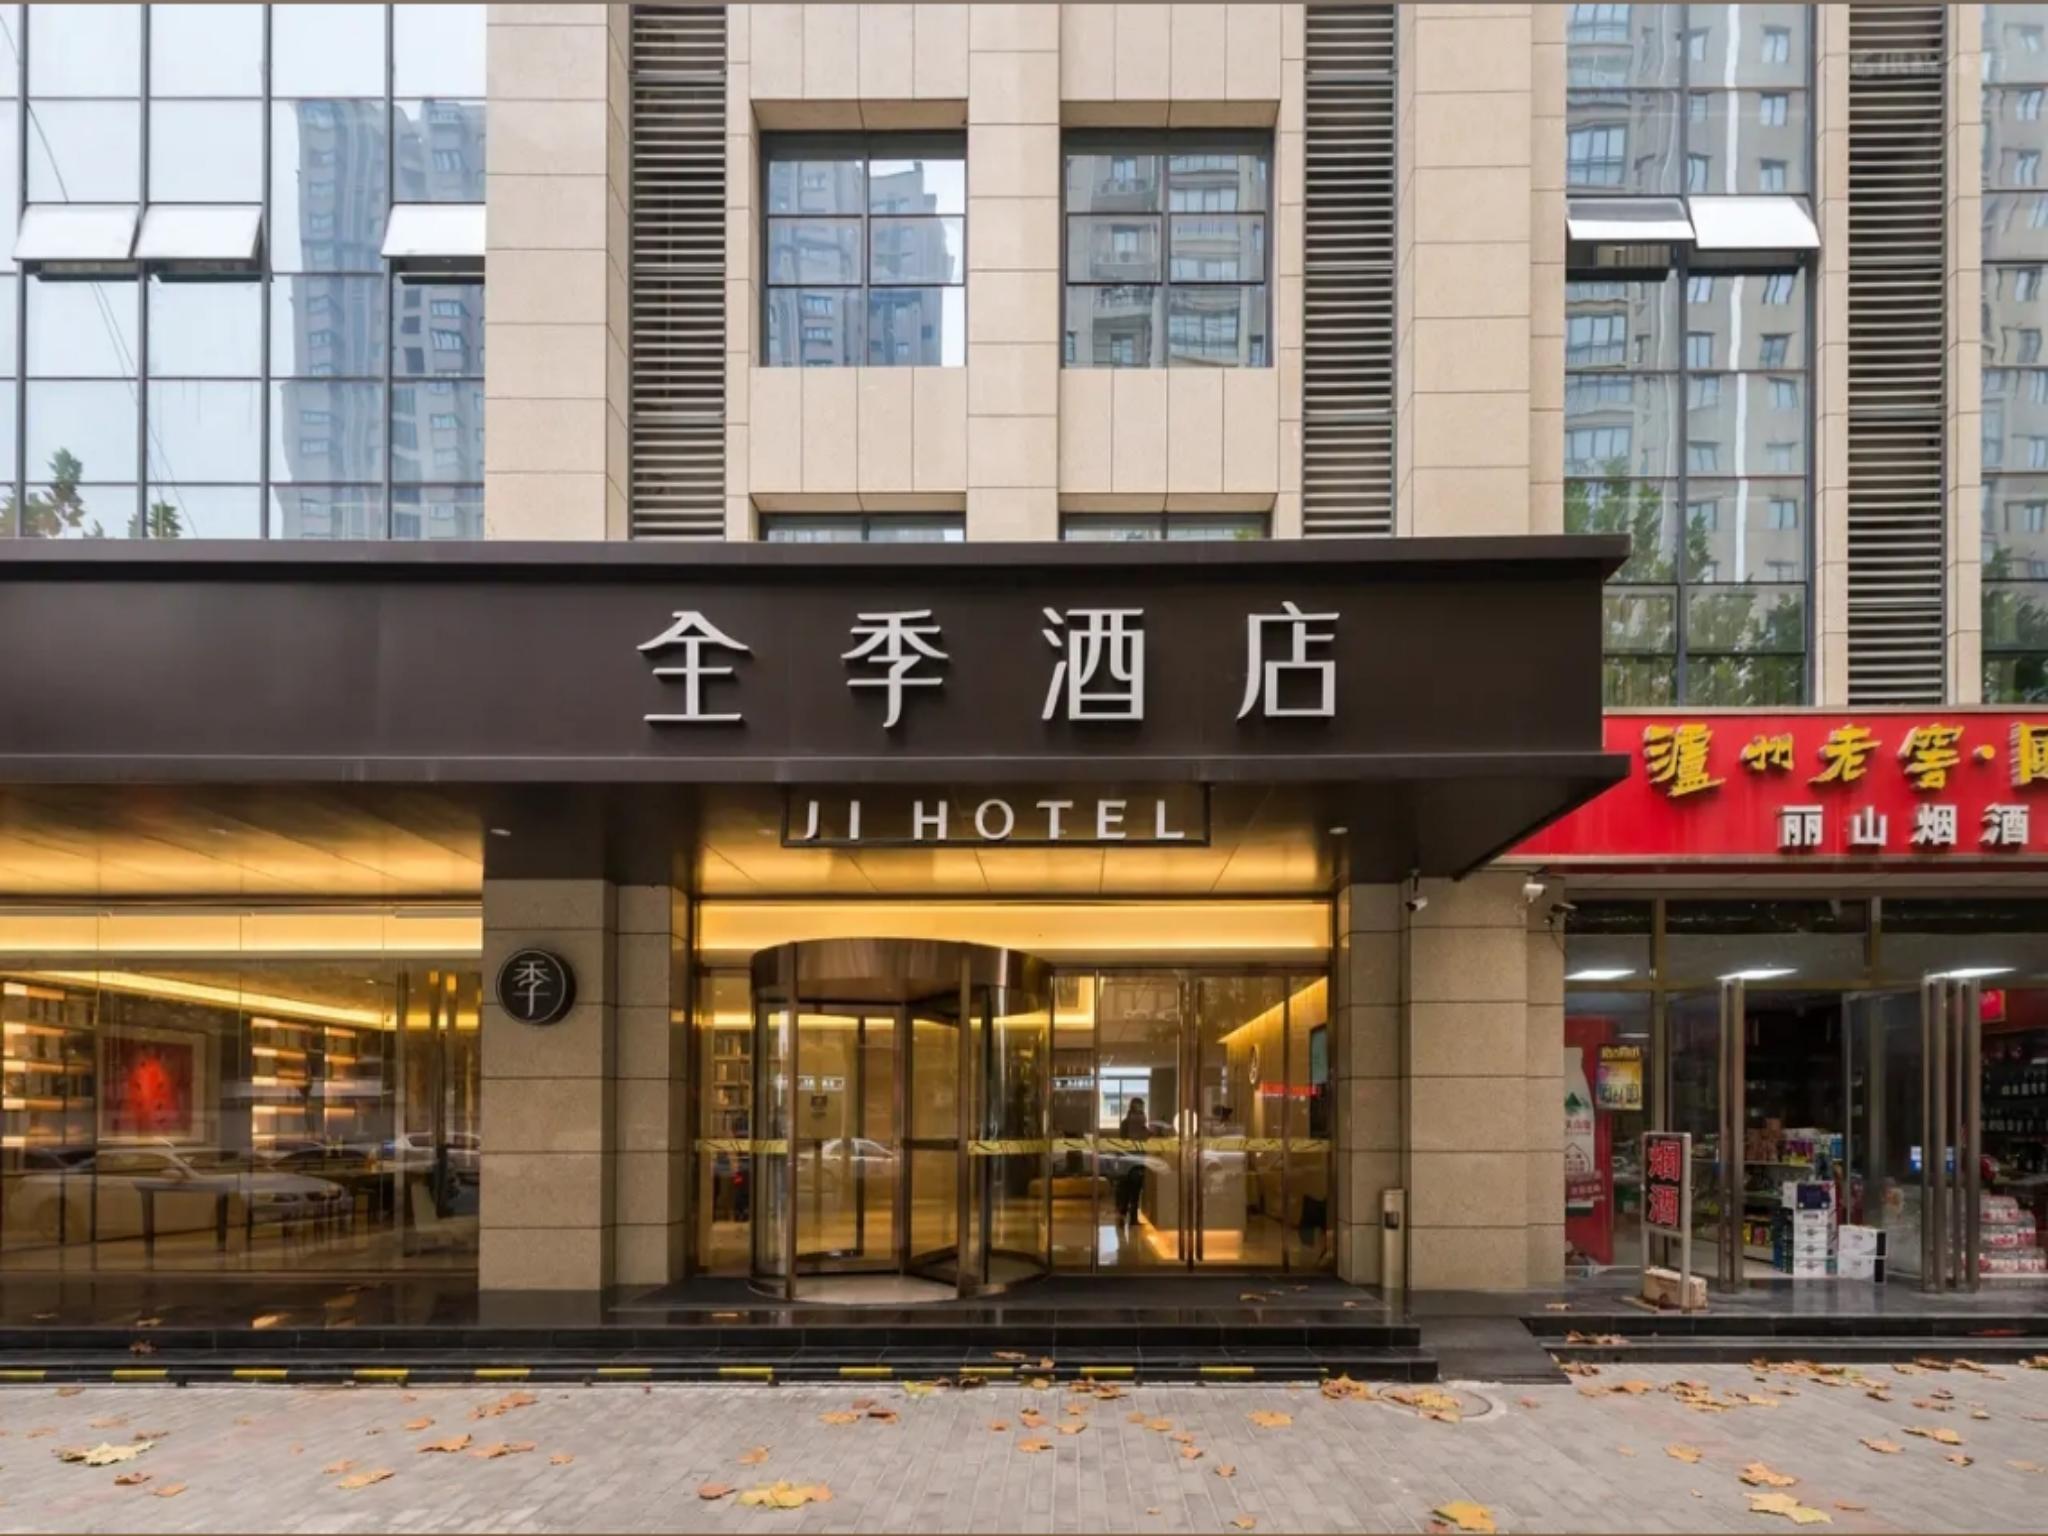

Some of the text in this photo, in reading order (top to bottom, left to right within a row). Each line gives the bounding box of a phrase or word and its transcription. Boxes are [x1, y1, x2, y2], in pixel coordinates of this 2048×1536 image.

[637, 601, 1341, 727] 全季酒店
[804, 801, 1186, 840] JI HOTEL
[1778, 804, 2030, 846] 丽山烟酒
[511, 960, 553, 1017] 季
[1648, 1138, 1681, 1228] 烟酒
